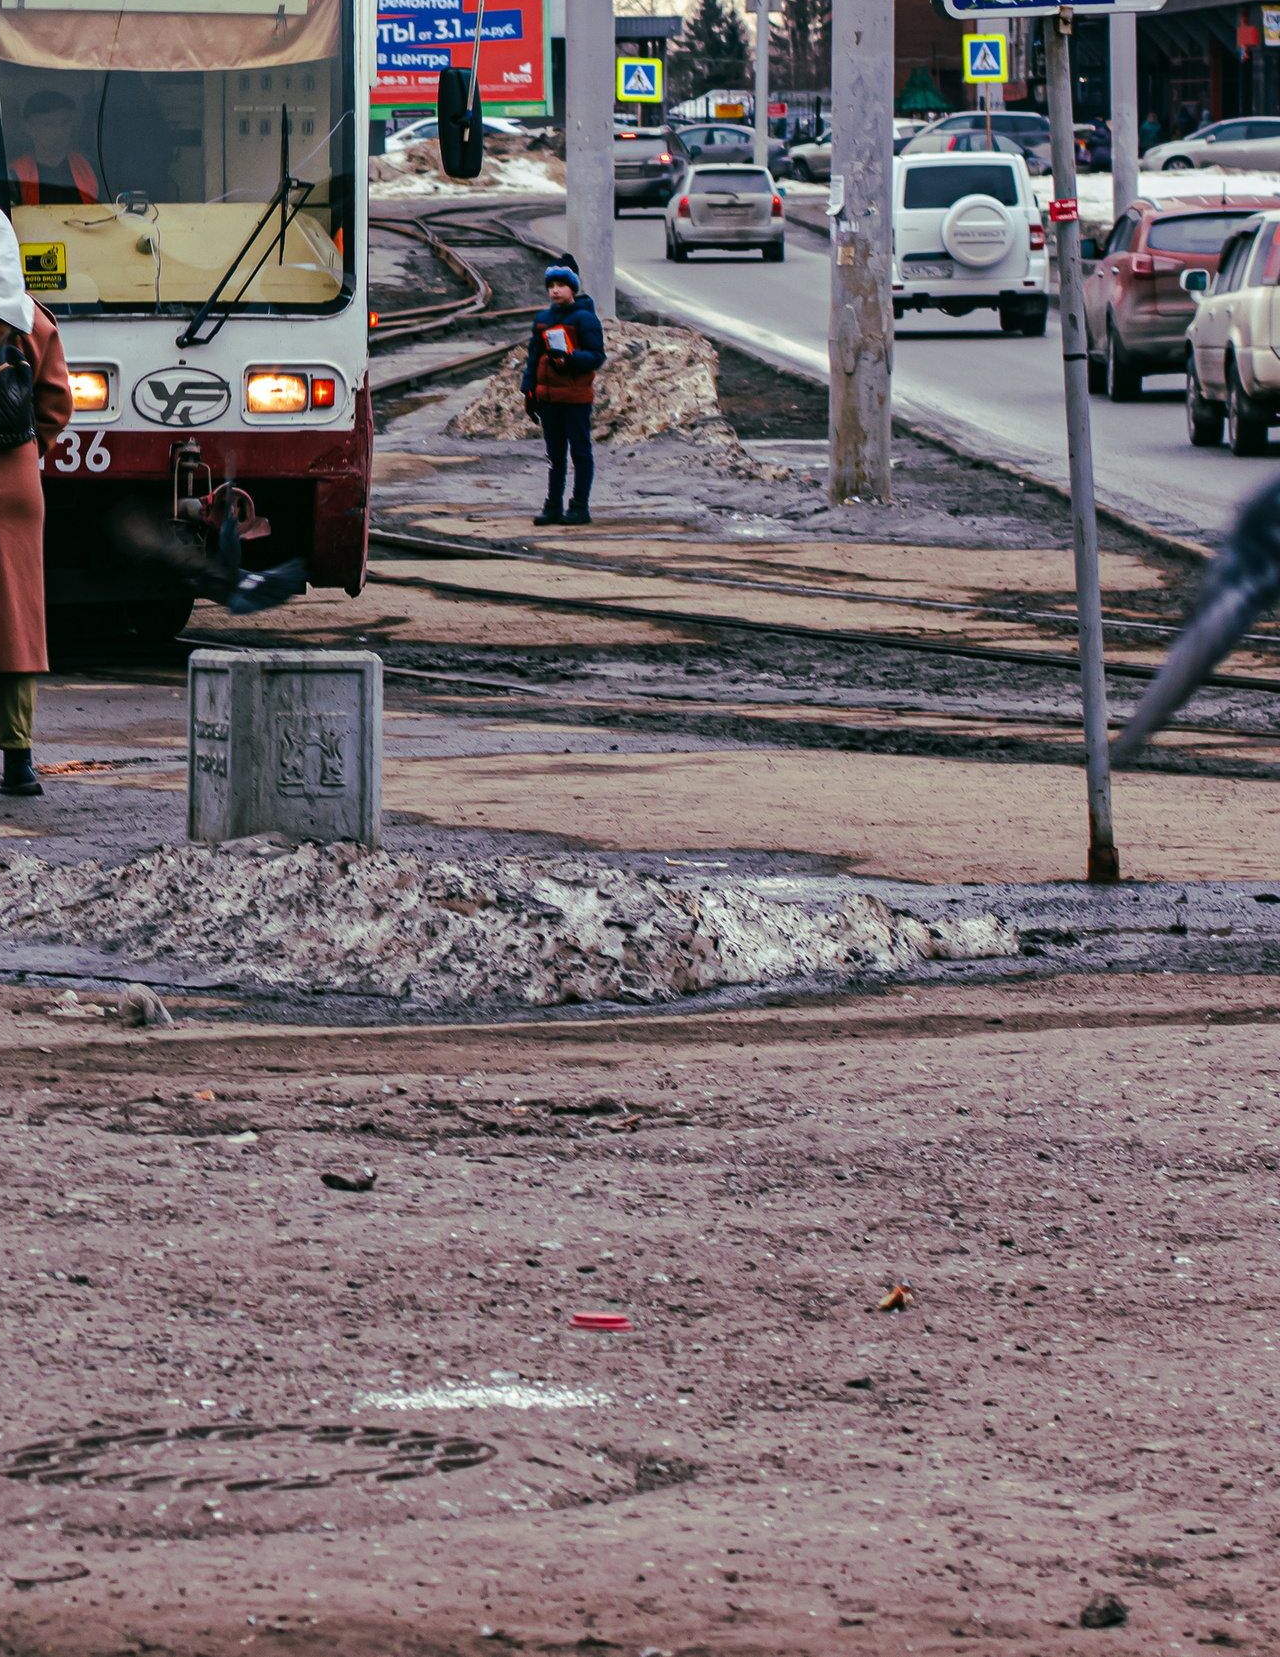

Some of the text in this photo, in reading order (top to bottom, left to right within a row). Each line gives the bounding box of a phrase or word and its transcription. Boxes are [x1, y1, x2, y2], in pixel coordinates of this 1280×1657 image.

[377, 22, 415, 43] ТЫ
[418, 31, 433, 41] от
[434, 18, 462, 40] 3.1
[391, 53, 449, 68] центре
[38, 429, 111, 473] 36
